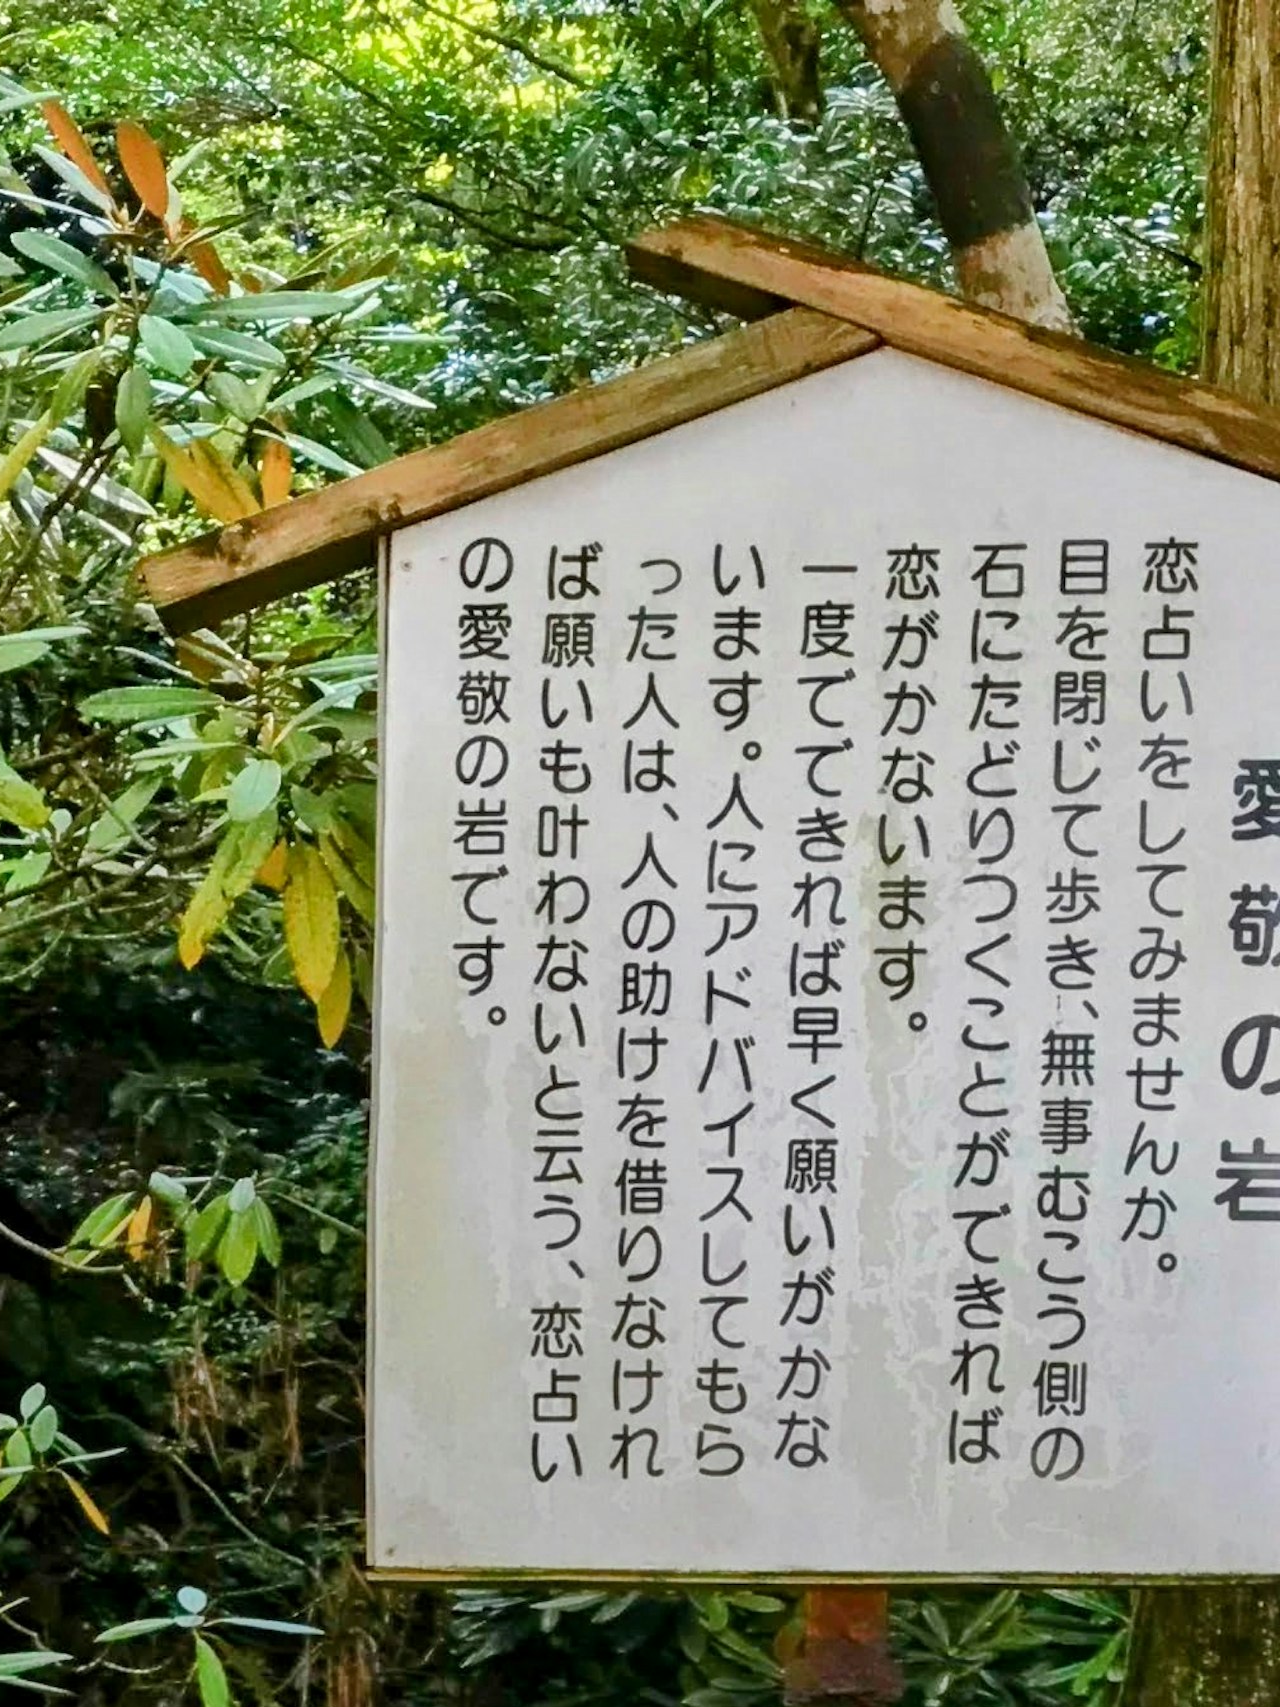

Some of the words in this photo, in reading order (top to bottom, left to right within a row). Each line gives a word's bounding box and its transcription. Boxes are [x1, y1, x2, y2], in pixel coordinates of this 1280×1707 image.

[451, 537, 514, 1026] の愛敬の岩です。
[530, 541, 603, 1483] ば願いも叶わないと云う、恋占い
[609, 558, 682, 1480] った人は、人の助けを借りなけれ
[696, 543, 765, 1477] います。人にアドバイスしてもら
[774, 564, 858, 1468] 一度でできれば早く願いがかな
[873, 542, 941, 1032] 恋がかないます。
[948, 543, 1028, 1465] 石にたどりつくことができれば
[1030, 539, 1110, 1481] 目を閉じて歩き、無事むこう側の
[1120, 536, 1200, 1273] 恋占いをしてみませんか。
